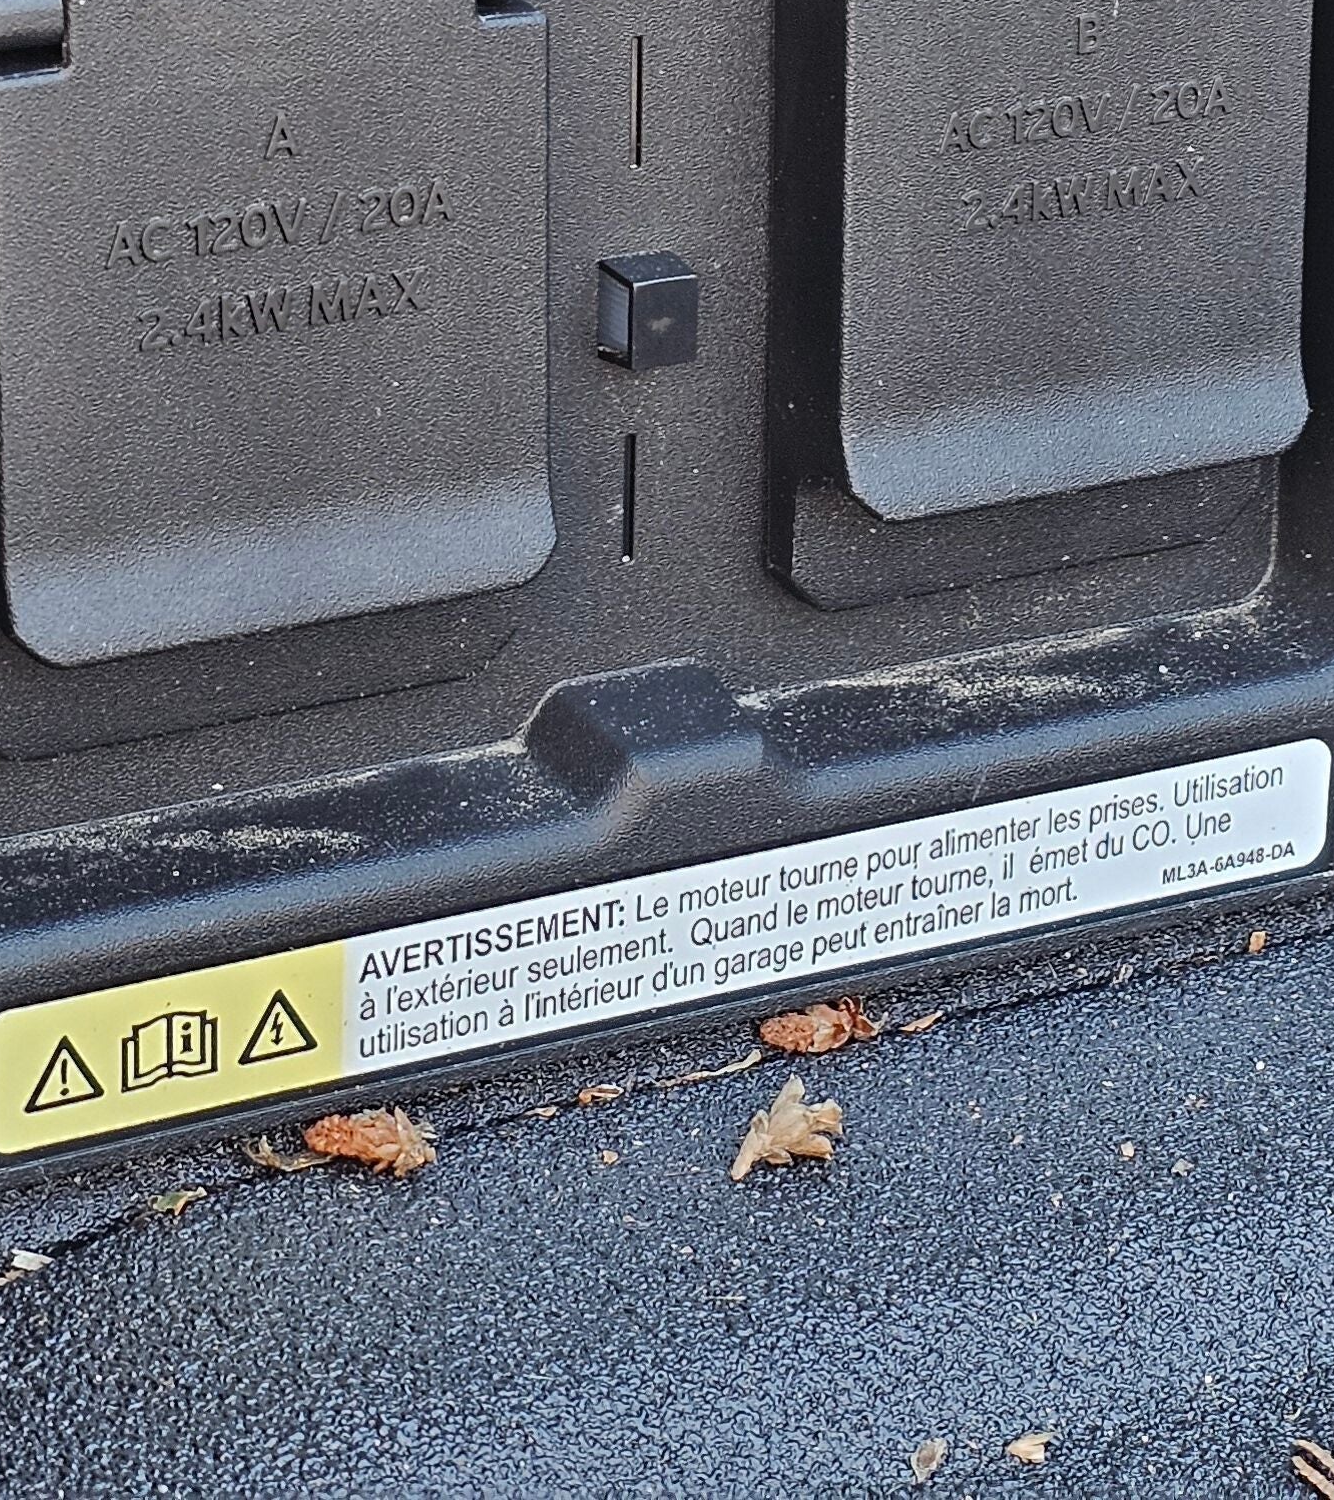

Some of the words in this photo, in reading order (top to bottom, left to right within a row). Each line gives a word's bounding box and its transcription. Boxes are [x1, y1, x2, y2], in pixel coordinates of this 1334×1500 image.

[1076, 12, 1100, 55] B
[265, 109, 300, 160] A
[939, 112, 994, 155] AC
[1004, 93, 1112, 145] 120V
[1117, 84, 1140, 133] /
[1150, 76, 1232, 126] 20A
[106, 218, 169, 270] AC
[186, 197, 308, 256] 120V
[320, 191, 343, 244] /
[360, 178, 456, 234] 20A
[963, 177, 1093, 231] 2.4kW
[1102, 155, 1205, 212] MAX
[137, 287, 293, 352] 2.4kW
[309, 266, 428, 326] MAX
[359, 901, 626, 983] AVERTISSEMENT:
[636, 889, 669, 922] Le
[679, 873, 771, 914] moteur
[779, 855, 858, 891] tourne
[868, 842, 921, 880] pour
[929, 817, 1041, 860] alimenter
[1047, 807, 1081, 835] les
[1088, 790, 1165, 831] prises.
[1174, 765, 1284, 808] Utilisation
[1162, 840, 1296, 884] ML3A-6A948-DA
[359, 992, 376, 1020] à
[386, 966, 518, 1013] l'extérieur
[527, 929, 674, 982] seulement.
[690, 903, 777, 948] Quand
[786, 893, 808, 928] le
[816, 884, 903, 920] moteur
[911, 864, 993, 899] tourne,
[1002, 853, 1013, 879] il
[1029, 843, 1088, 873] émet
[1095, 830, 1124, 860] du
[1131, 821, 1175, 853] CO.
[1186, 811, 1231, 839] Une
[359, 1009, 489, 1058] utilisation
[499, 999, 515, 1025] à
[523, 975, 645, 1023] l'intérieur
[651, 960, 706, 993] d'un
[713, 940, 804, 986] garage
[812, 921, 867, 965] peut
[874, 903, 983, 944] entraîner
[991, 892, 1010, 919] la
[1019, 876, 1078, 913] mort.
